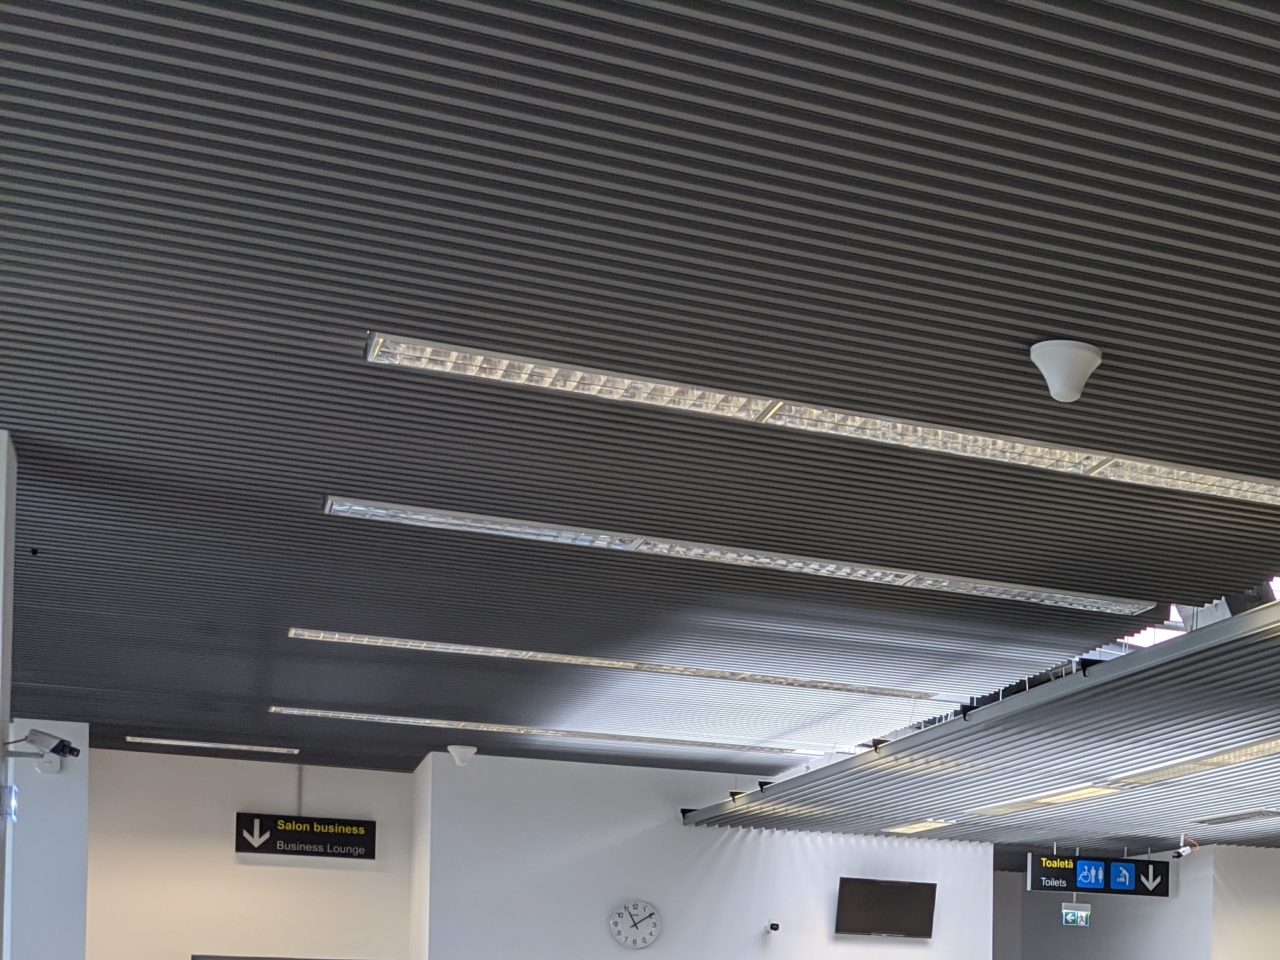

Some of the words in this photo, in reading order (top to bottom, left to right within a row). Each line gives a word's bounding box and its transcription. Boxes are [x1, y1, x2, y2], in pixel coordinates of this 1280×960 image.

[276, 819, 310, 832] Salon
[313, 821, 366, 835] business
[276, 840, 325, 853] Business
[327, 843, 366, 857] Lounge
[1040, 857, 1075, 869] Toaletă
[1040, 876, 1067, 888] Toilets
